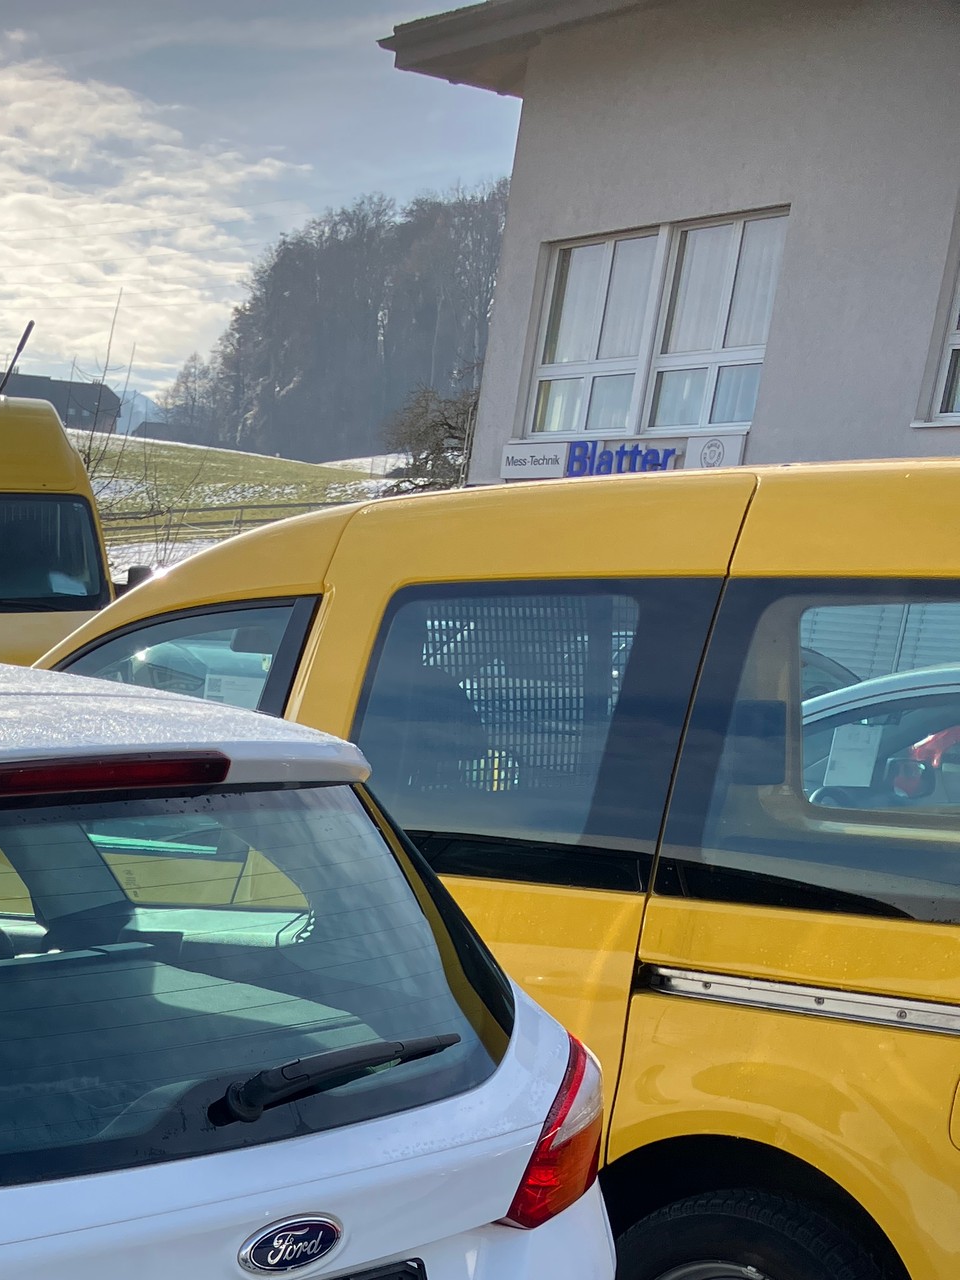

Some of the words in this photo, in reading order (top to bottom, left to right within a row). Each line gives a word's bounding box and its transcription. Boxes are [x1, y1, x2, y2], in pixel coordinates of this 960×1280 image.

[505, 454, 560, 467] Mess-Technik
[567, 440, 676, 478] Blatter
[267, 1226, 324, 1265] Ford
